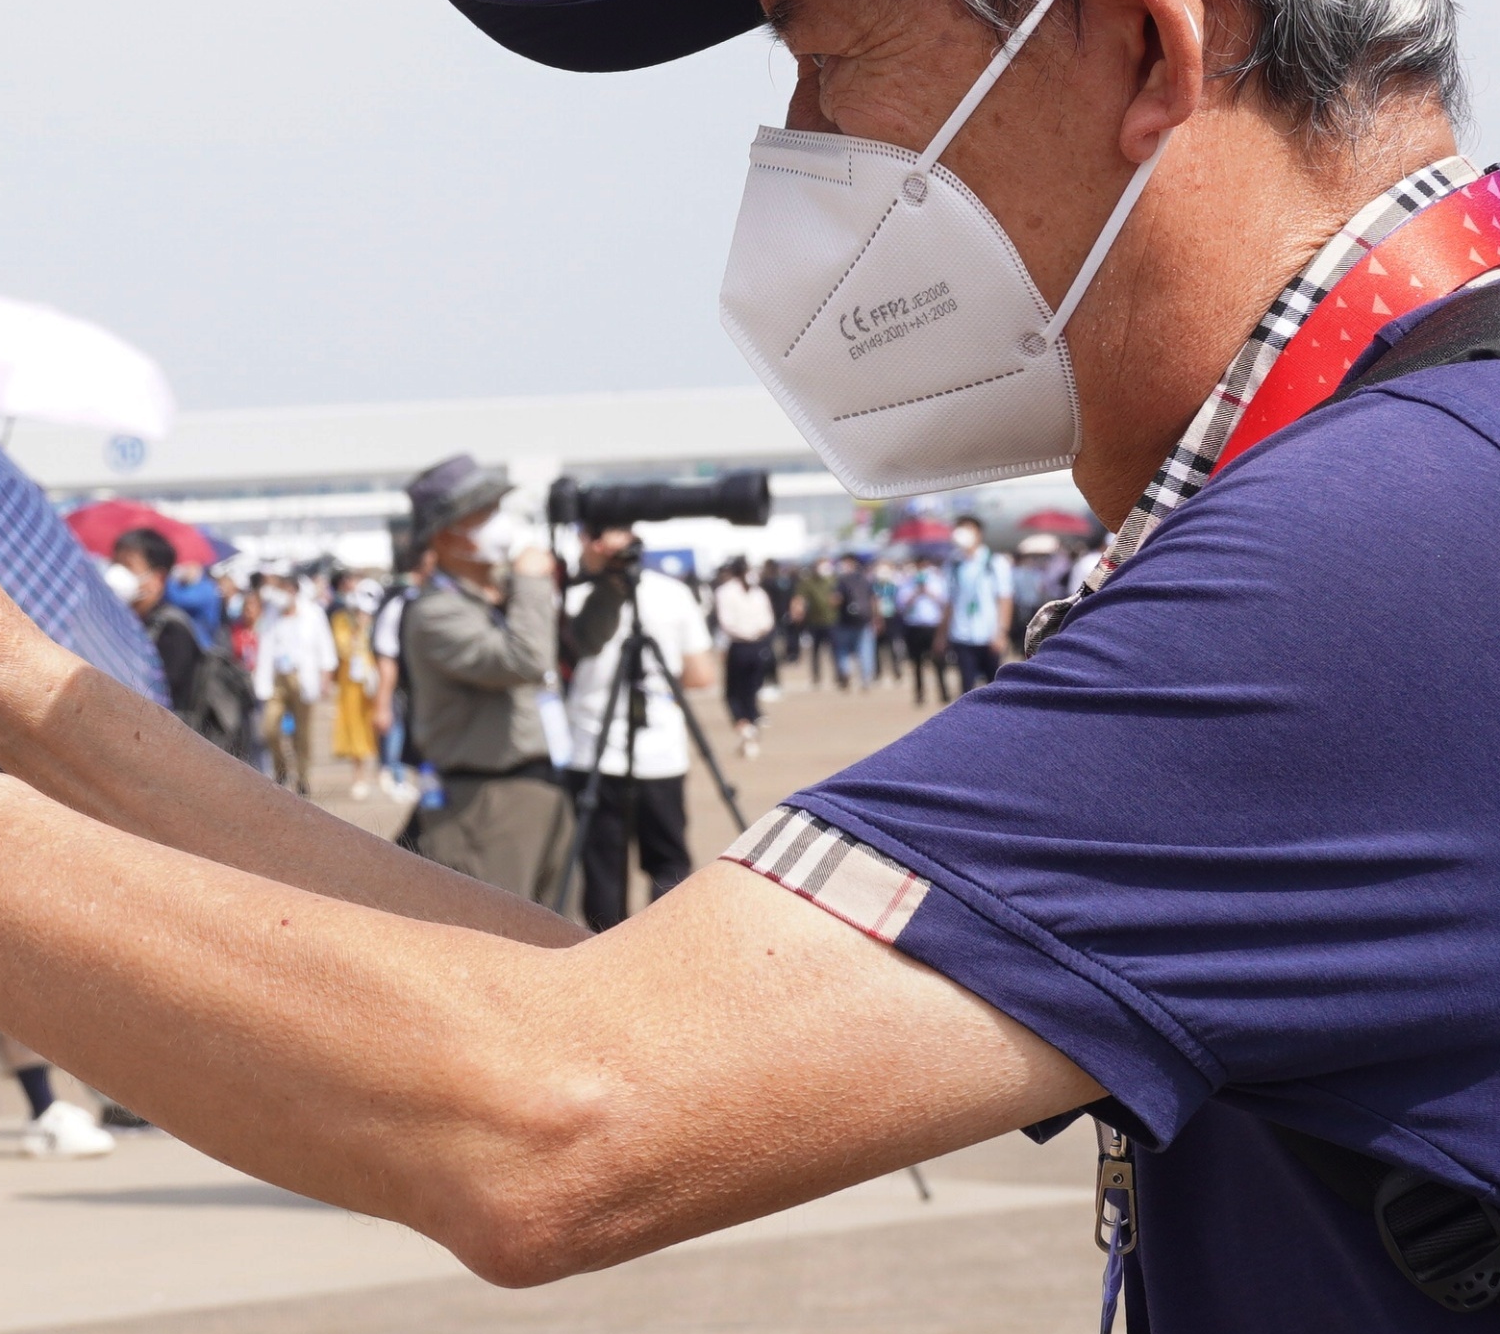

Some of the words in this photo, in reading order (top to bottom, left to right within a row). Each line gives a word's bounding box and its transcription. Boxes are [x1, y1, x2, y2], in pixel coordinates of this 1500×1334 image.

[840, 305, 870, 341] CE
[870, 297, 910, 327] FFP2
[848, 298, 958, 360] EN149:2001+A1:2009
